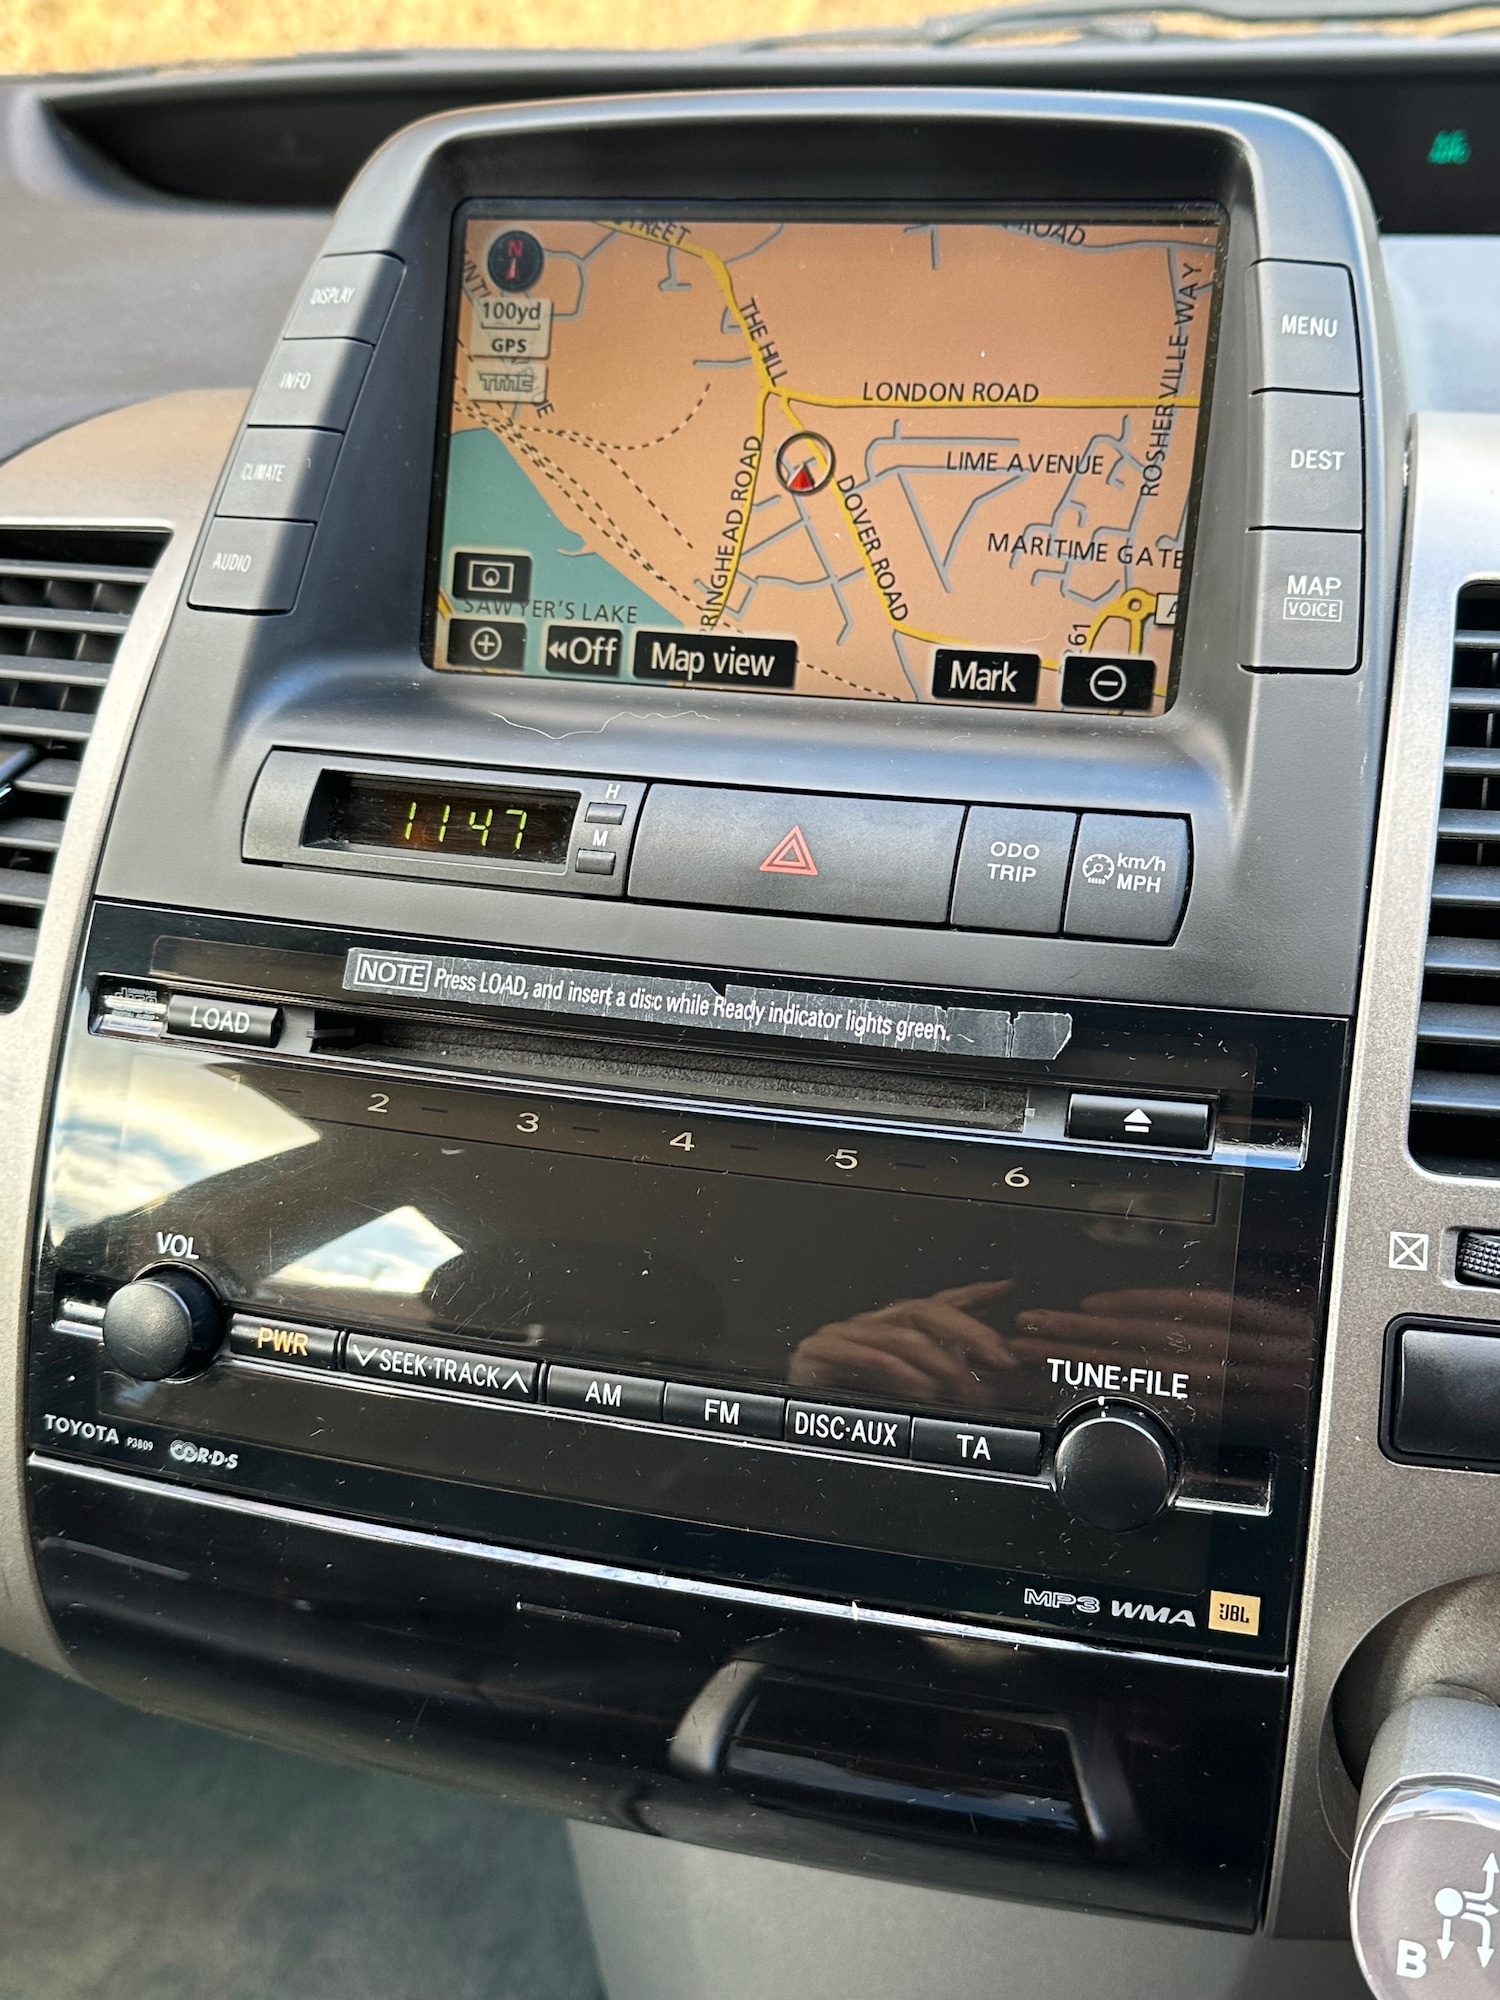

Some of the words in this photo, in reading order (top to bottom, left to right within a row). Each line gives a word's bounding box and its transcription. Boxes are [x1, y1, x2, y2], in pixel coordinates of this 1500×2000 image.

[310, 287, 356, 305] DISPLAY
[1174, 262, 1202, 326] WAY
[483, 302, 541, 324] 100yd
[1281, 314, 1338, 338] MENU
[491, 338, 527, 353] GPS
[738, 298, 769, 342] THE
[758, 341, 788, 387] HILL
[280, 372, 311, 390] INFO
[862, 382, 964, 402] LONDON
[972, 383, 1039, 403] ROAD
[946, 451, 998, 472] LIME
[1007, 454, 1104, 476] AVENUE
[1290, 450, 1345, 471] DEST
[241, 464, 286, 482] CLIMATE
[699, 509, 744, 631] RINGHEAD
[730, 437, 761, 503] ROAD
[836, 475, 881, 555] DOVER
[870, 558, 909, 622] ROAD
[987, 533, 1108, 562] MARITIME
[212, 553, 252, 573] AUDIO
[1287, 575, 1342, 597] MAP
[582, 603, 638, 624] LAKE
[1288, 601, 1339, 618] VOICE
[569, 636, 618, 667] Off
[651, 641, 705, 681] Map
[713, 648, 775, 677] view
[949, 659, 1017, 693] Mark
[605, 784, 621, 799] H
[592, 829, 607, 847] M
[990, 841, 1040, 861] ODO
[1117, 852, 1167, 872] km/h
[987, 863, 1037, 883] TRIP
[1116, 873, 1162, 894] MPH
[360, 959, 425, 988] NOTE
[434, 968, 477, 993] Press
[479, 972, 530, 1001] LOAD,
[532, 980, 565, 1002] and
[568, 980, 612, 1006] insert
[615, 991, 627, 1007] a
[630, 987, 663, 1010] disc
[666, 992, 709, 1017] while
[713, 995, 766, 1023] Ready
[768, 1001, 844, 1031] indicator
[846, 1009, 893, 1038] lights
[896, 1019, 951, 1043] green.
[190, 1005, 250, 1034] LOAD
[367, 1092, 390, 1114] 2
[516, 1112, 540, 1133] 3
[669, 1131, 695, 1152] 4
[834, 1148, 858, 1170] 5
[1004, 1166, 1031, 1188] 6
[157, 1231, 199, 1260] VOL
[257, 1327, 309, 1356] PWR
[584, 1381, 622, 1408] AM
[704, 1400, 740, 1426] FM
[43, 1413, 119, 1445] TOYOTA
[126, 1437, 153, 1452] P3809
[956, 1434, 991, 1461] TA
[1024, 1588, 1100, 1614] MP3
[1111, 1600, 1196, 1628] WMA
[1219, 1603, 1249, 1624] JBL
[1396, 1939, 1427, 1979] B
